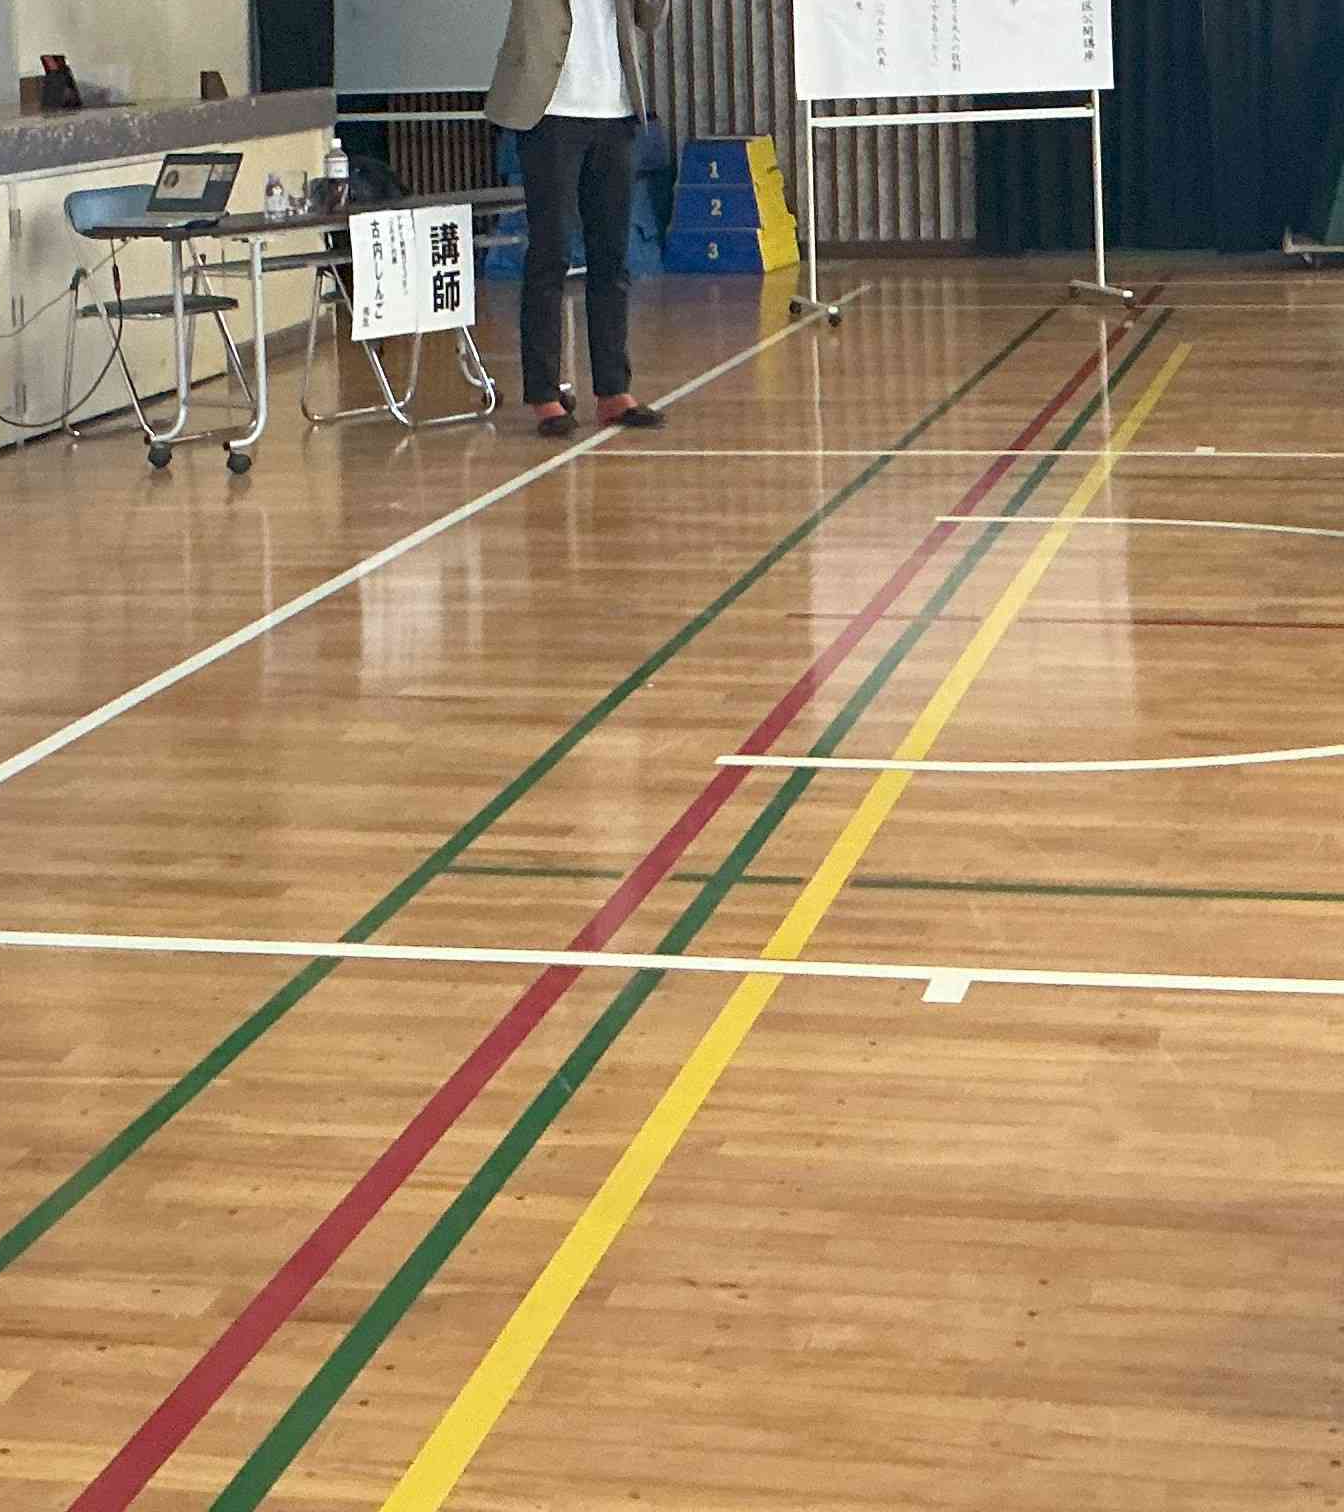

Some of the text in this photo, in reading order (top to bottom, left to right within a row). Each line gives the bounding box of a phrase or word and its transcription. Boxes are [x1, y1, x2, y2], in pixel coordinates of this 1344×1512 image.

[709, 161, 719, 178] 1
[711, 199, 722, 216] 2
[708, 242, 719, 260] 3
[370, 219, 385, 320] 古内しんご
[430, 222, 460, 313] 講師
